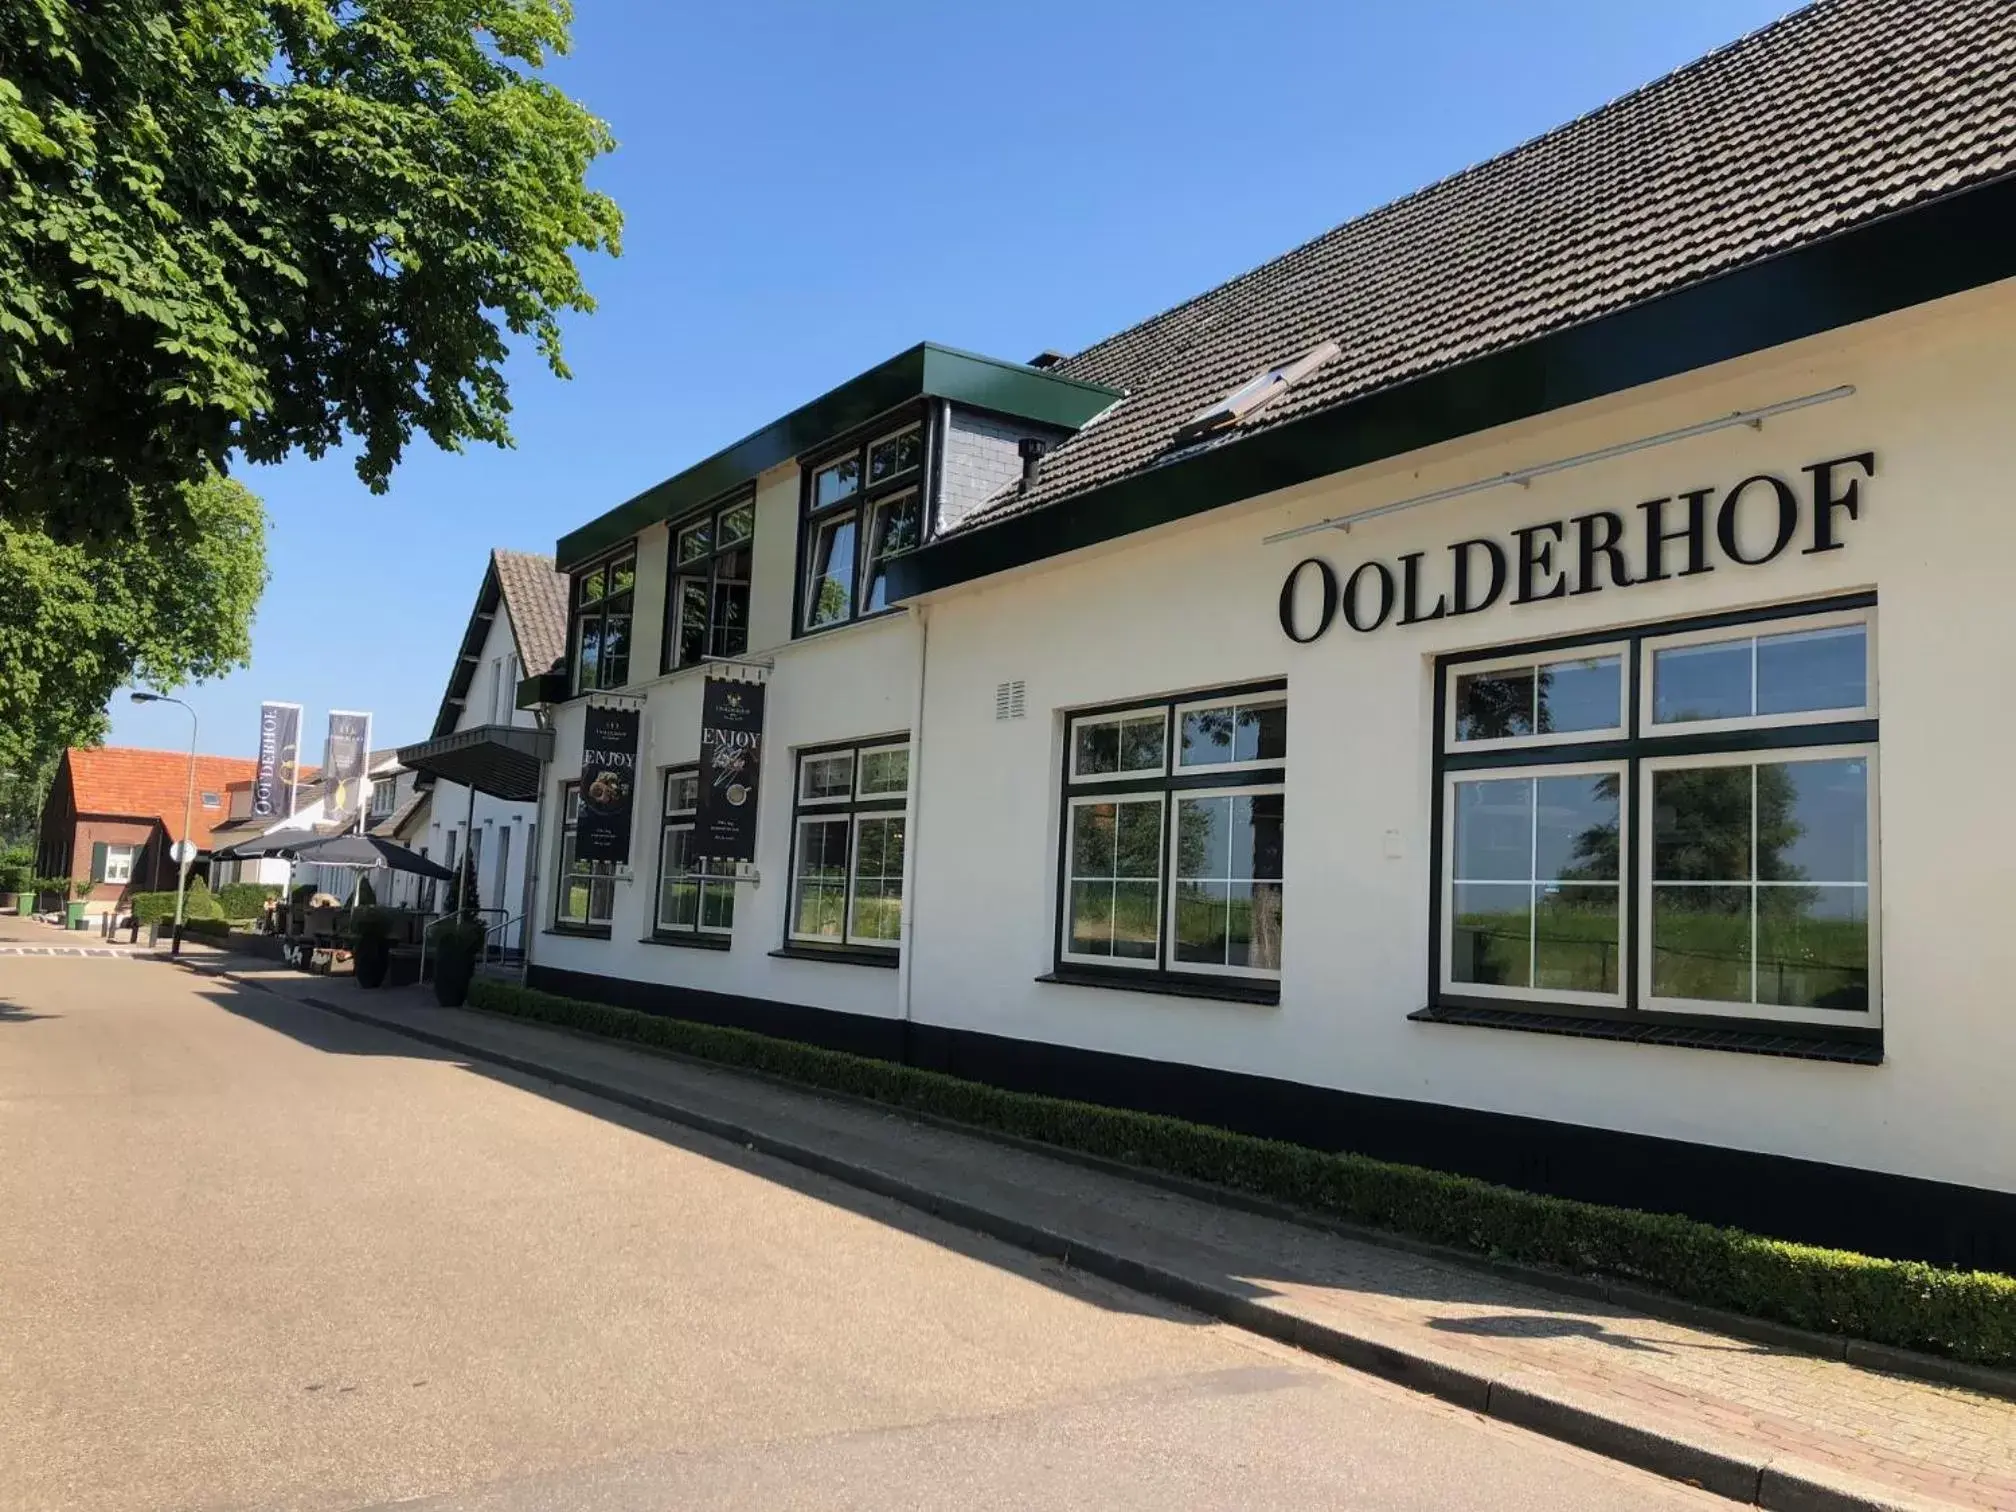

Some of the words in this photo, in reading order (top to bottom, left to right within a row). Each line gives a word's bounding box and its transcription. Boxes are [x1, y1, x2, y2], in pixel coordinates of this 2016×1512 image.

[1278, 450, 1876, 644] OOLDERHOF
[703, 727, 761, 749] ENJOY
[584, 749, 637, 768] ENJOY
